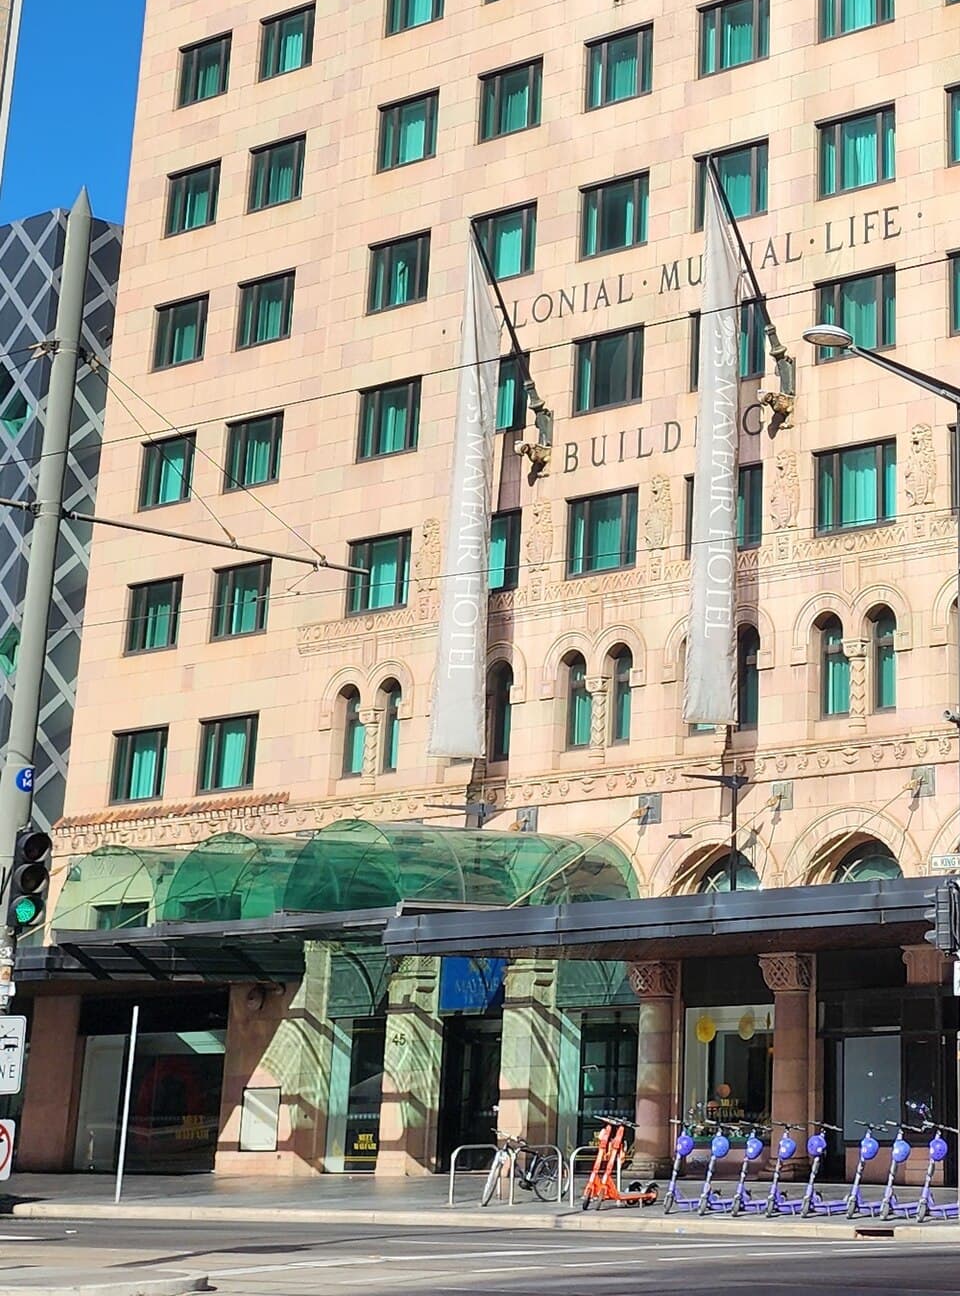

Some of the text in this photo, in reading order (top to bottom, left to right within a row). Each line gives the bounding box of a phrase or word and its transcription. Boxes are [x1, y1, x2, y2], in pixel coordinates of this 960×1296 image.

[460, 273, 634, 336] LONIAL
[824, 205, 902, 254] LIFE
[447, 431, 487, 680] MAYFAIR HOTEL
[704, 375, 736, 639] MAYFAIR HOTEL
[940, 856, 956, 867] KING
[391, 1033, 408, 1047] 45
